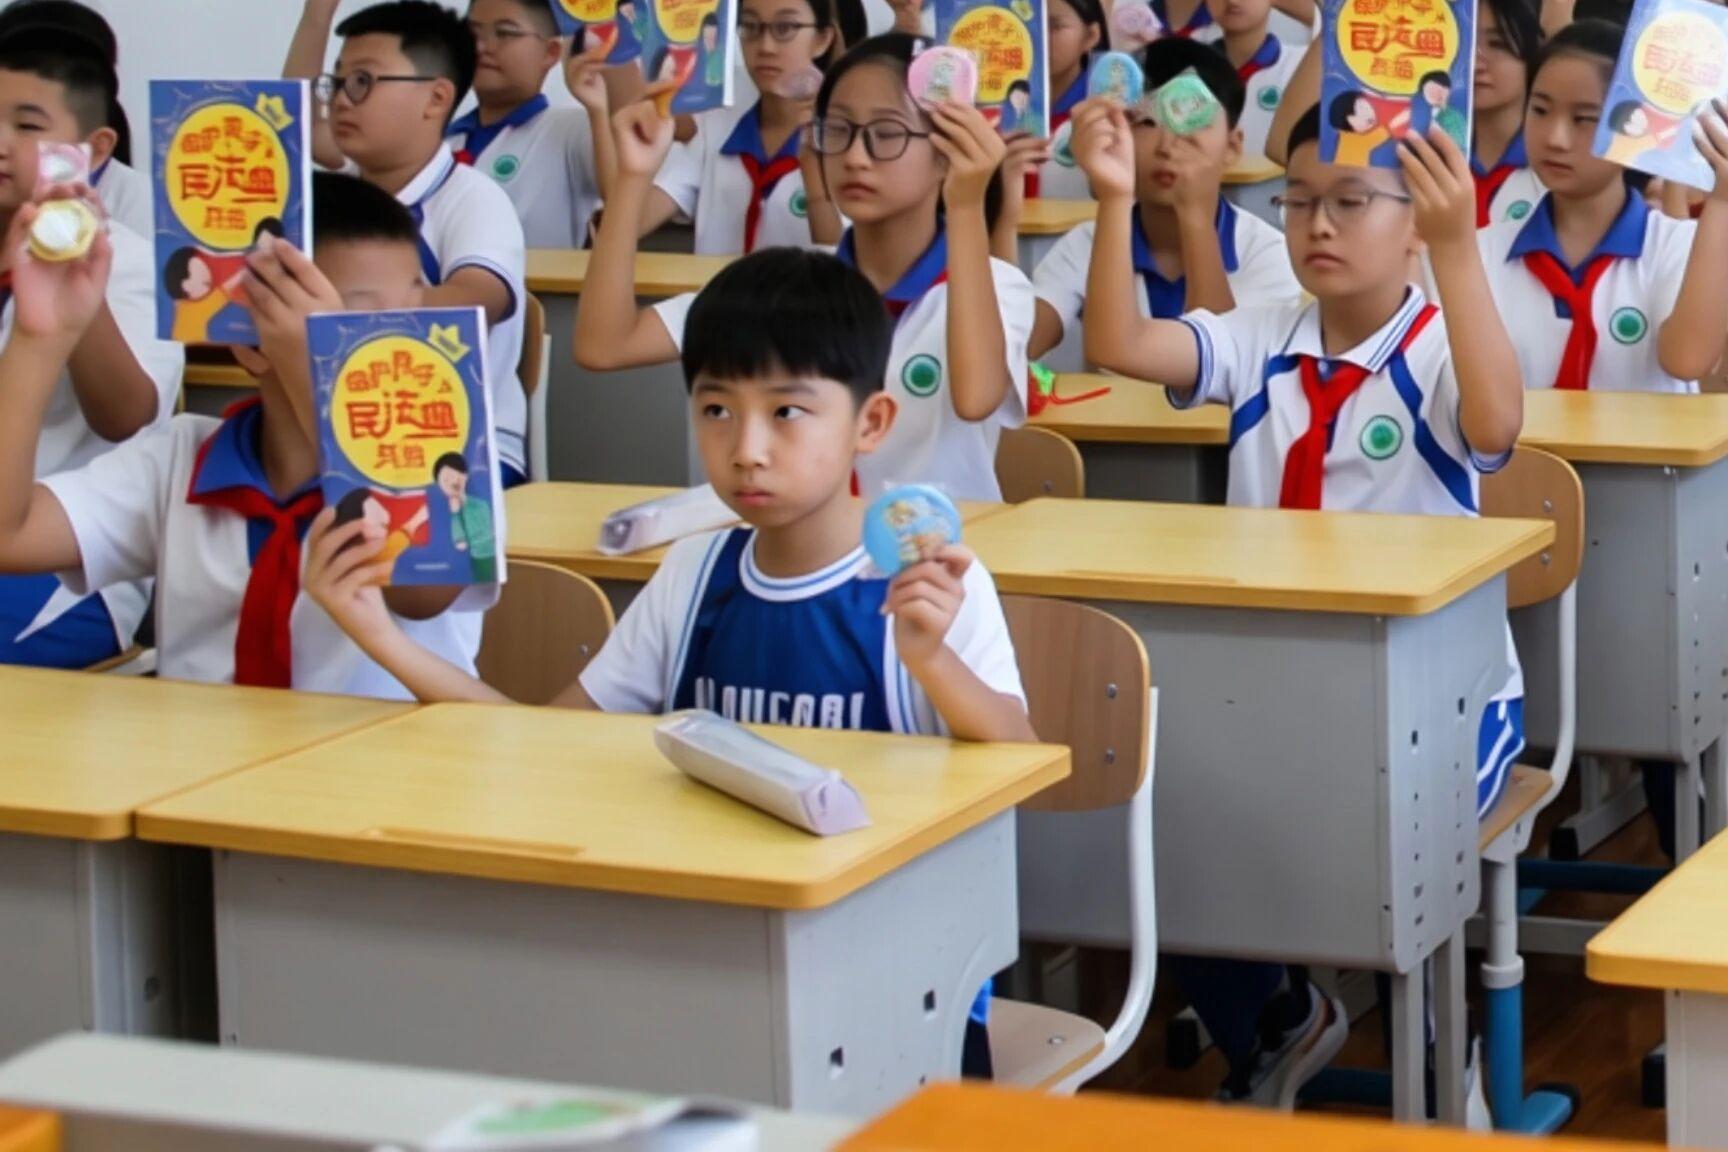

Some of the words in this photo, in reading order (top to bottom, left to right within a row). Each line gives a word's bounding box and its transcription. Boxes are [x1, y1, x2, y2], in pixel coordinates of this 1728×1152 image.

[1348, 14, 1445, 58] 民法典
[345, 389, 459, 440] 民法典
